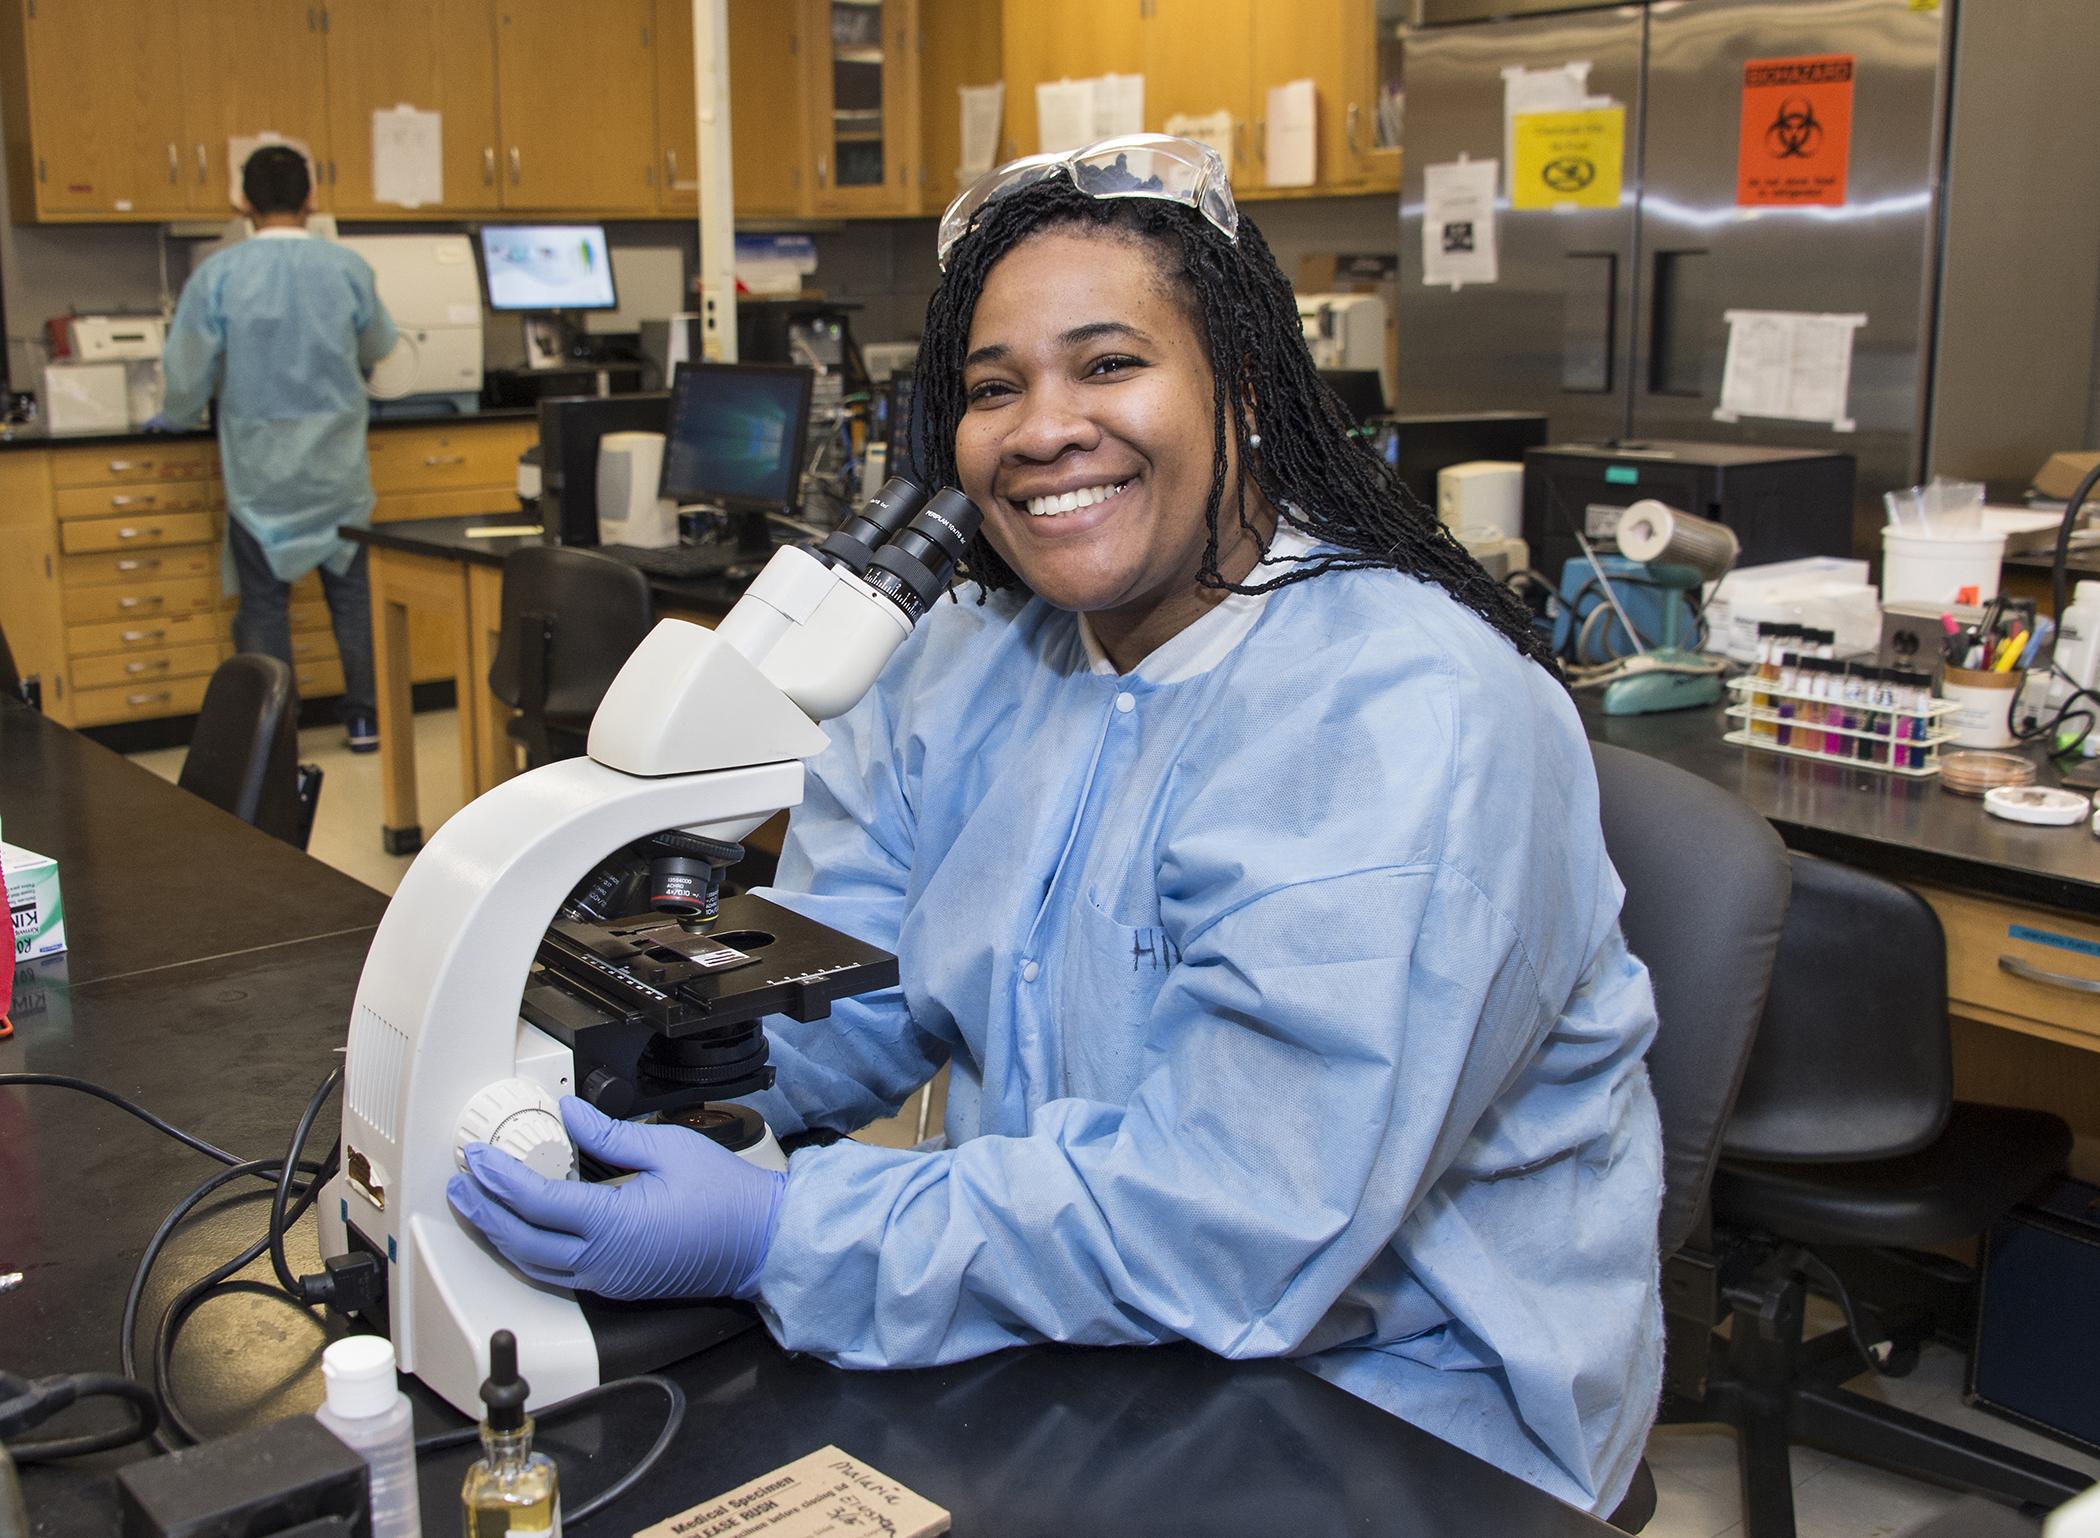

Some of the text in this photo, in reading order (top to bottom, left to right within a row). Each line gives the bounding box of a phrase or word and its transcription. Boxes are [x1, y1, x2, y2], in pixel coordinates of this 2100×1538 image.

[1746, 64, 1851, 87] BIOHAZARD
[671, 1505, 729, 1534] Medical
[728, 1476, 795, 1508] Specimen
[740, 1499, 779, 1521] RUSH
